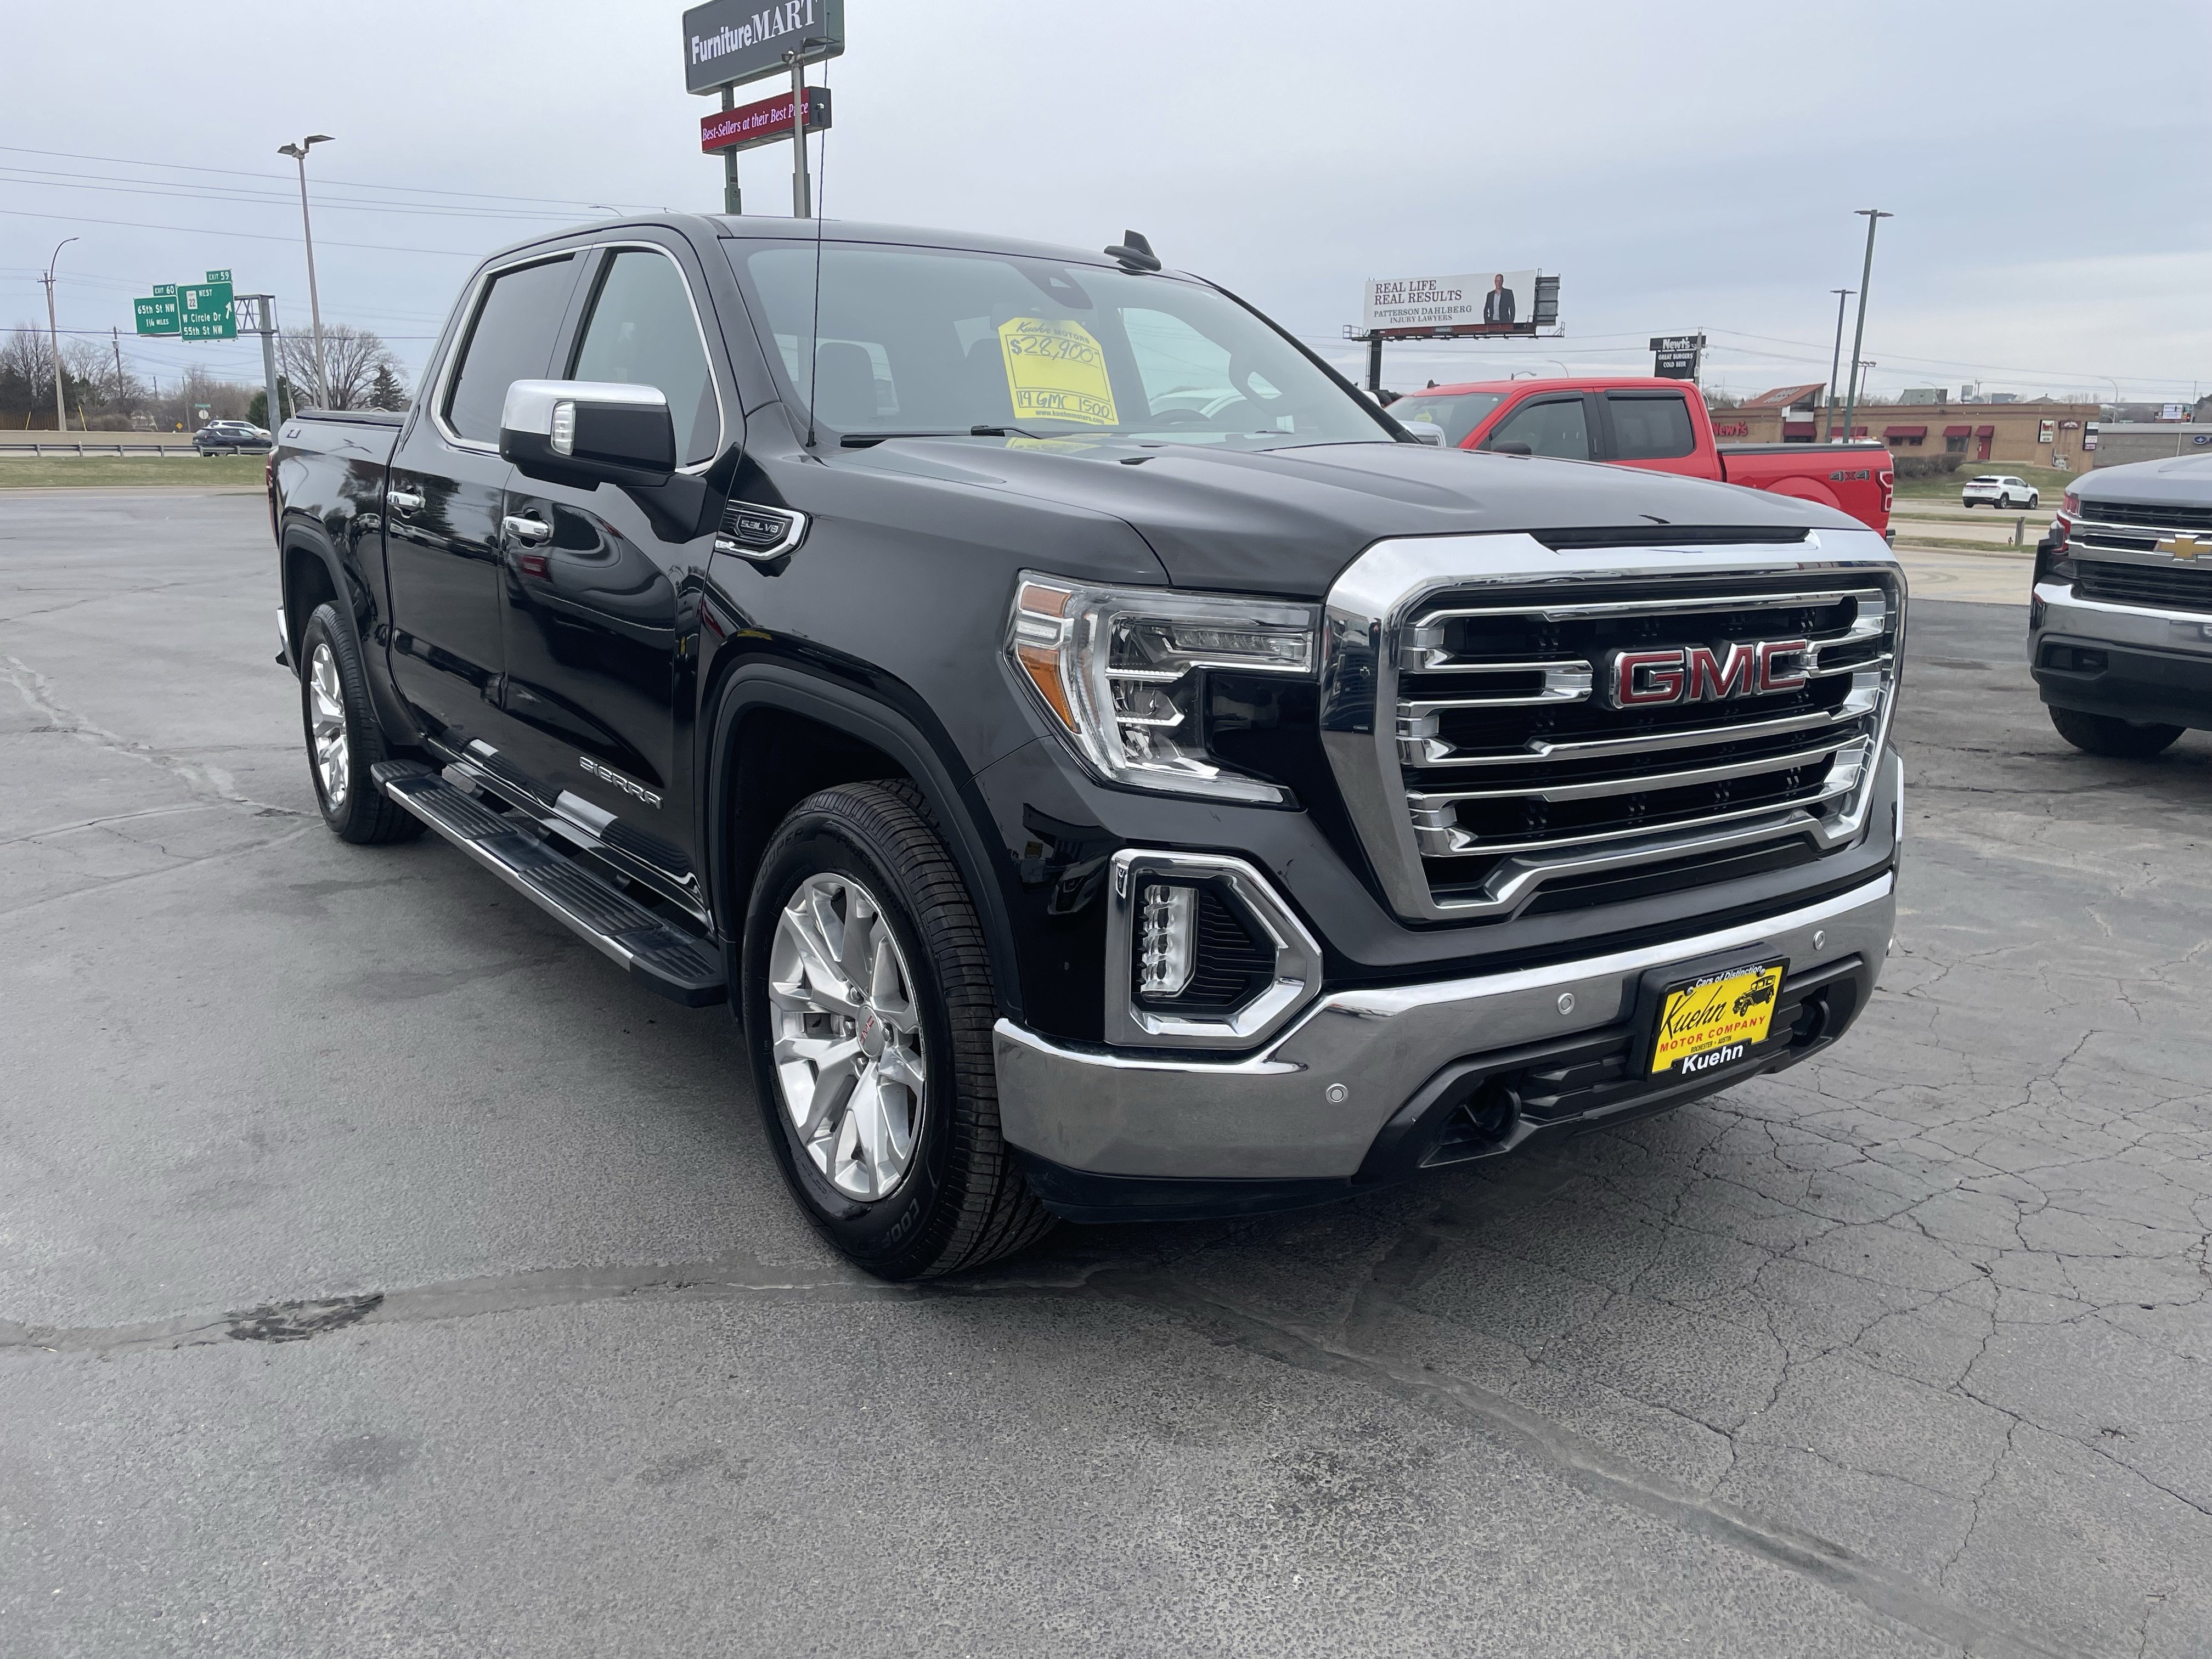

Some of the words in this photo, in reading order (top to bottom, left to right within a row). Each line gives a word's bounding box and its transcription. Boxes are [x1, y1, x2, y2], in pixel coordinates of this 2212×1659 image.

[691, 0, 817, 65] FurnitureMART
[702, 120, 741, 142] Best-Sellers
[742, 119, 750, 130] at
[751, 111, 769, 127] their
[770, 106, 787, 123] Best
[788, 103, 809, 118] Pce
[221, 272, 229, 280] 59
[166, 286, 174, 294] 60
[1375, 281, 1406, 294] REAL
[1409, 280, 1437, 292] LIFE
[189, 298, 196, 307] 22
[1374, 293, 1406, 306] REAL
[1408, 290, 1462, 303] RESULTS
[138, 306, 153, 314] 65th
[155, 304, 163, 313] St
[165, 303, 174, 313] NW
[1374, 308, 1420, 317] PATTERSON
[1421, 305, 1472, 315] DAHLBERG
[182, 314, 188, 323] W
[191, 313, 211, 323] Circle
[213, 312, 221, 321] Dr
[1390, 315, 1417, 324] INJURY
[1418, 314, 1453, 323] LAWYERS
[183, 326, 200, 336] 55th
[202, 325, 210, 335] St
[212, 325, 223, 335] NW
[1016, 321, 1052, 334] Kuehn
[1054, 329, 1090, 343] MOTORS
[1662, 337, 1690, 349] Newt's
[1036, 392, 1068, 408] GMC
[1079, 397, 1110, 418] 1500
[1035, 410, 1105, 425] www.kuehnmotors.com
[1712, 421, 1747, 436] Newt's
[765, 523, 778, 533] V8
[1613, 638, 1808, 709] GMC
[579, 756, 663, 810] SIERRA
[1696, 977, 1714, 988] Cars
[1714, 973, 1724, 983] of
[1724, 964, 1763, 981] Distinction
[1658, 985, 1727, 1040] Kuehn
[860, 1015, 874, 1046] GMC
[1660, 1031, 1703, 1053] MOTOR
[1708, 1015, 1765, 1039] COMPANY
[1681, 1043, 1744, 1074] Kuehn
